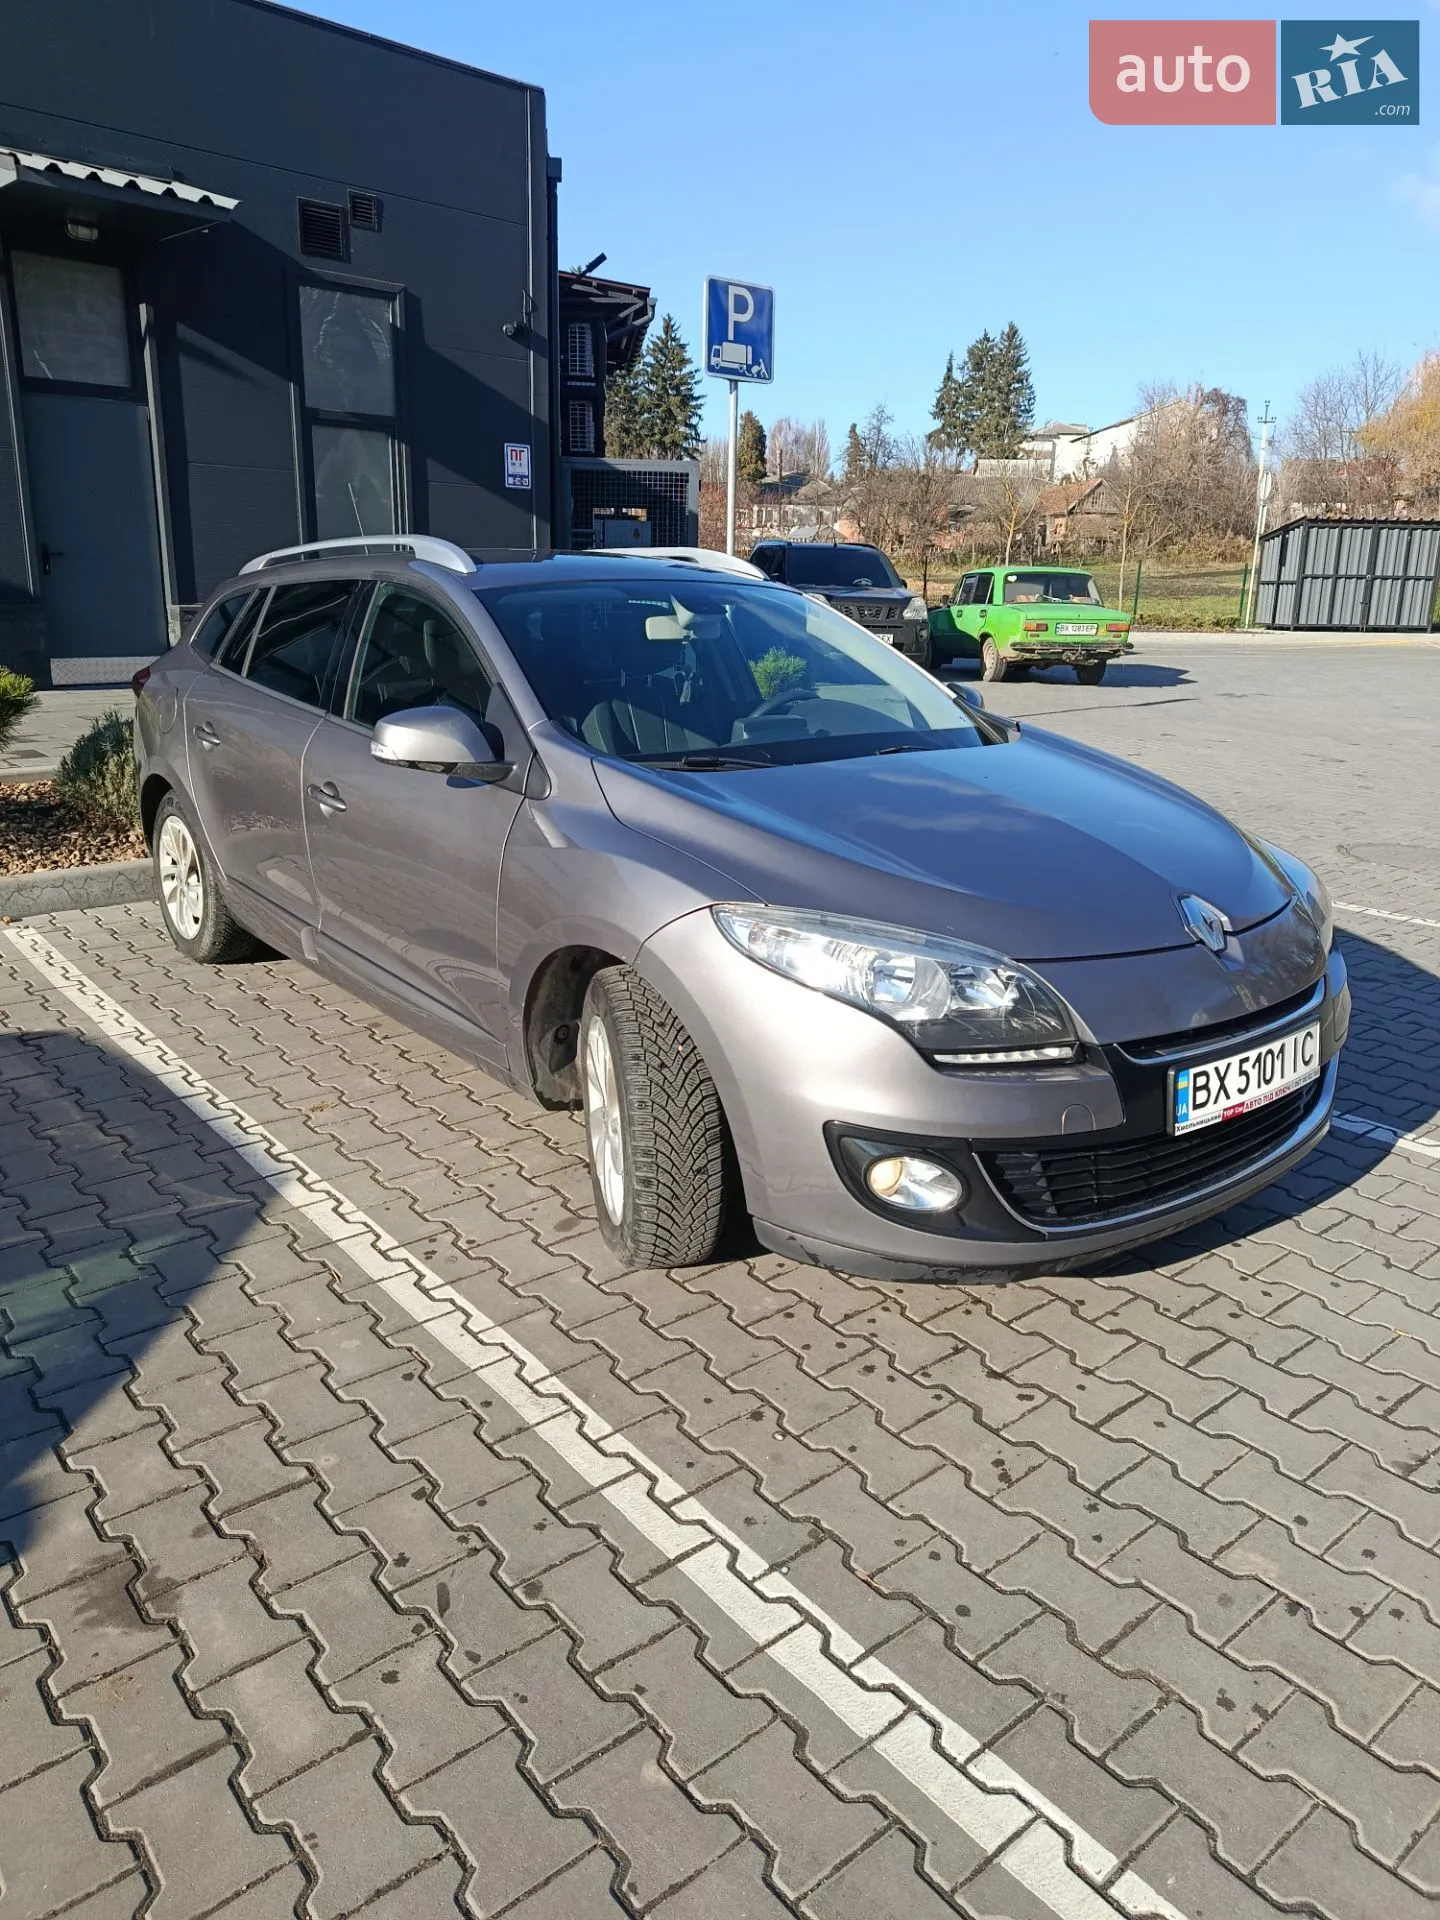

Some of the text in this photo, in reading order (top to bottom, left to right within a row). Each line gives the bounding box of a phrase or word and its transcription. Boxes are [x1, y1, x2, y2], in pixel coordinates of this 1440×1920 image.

[728, 284, 755, 341] P
[1192, 1031, 1314, 1112] BX 5101 IC
[1175, 1103, 1188, 1117] UA
[1245, 1097, 1263, 1111] АВТО
[1263, 1094, 1274, 1103] ПІД
